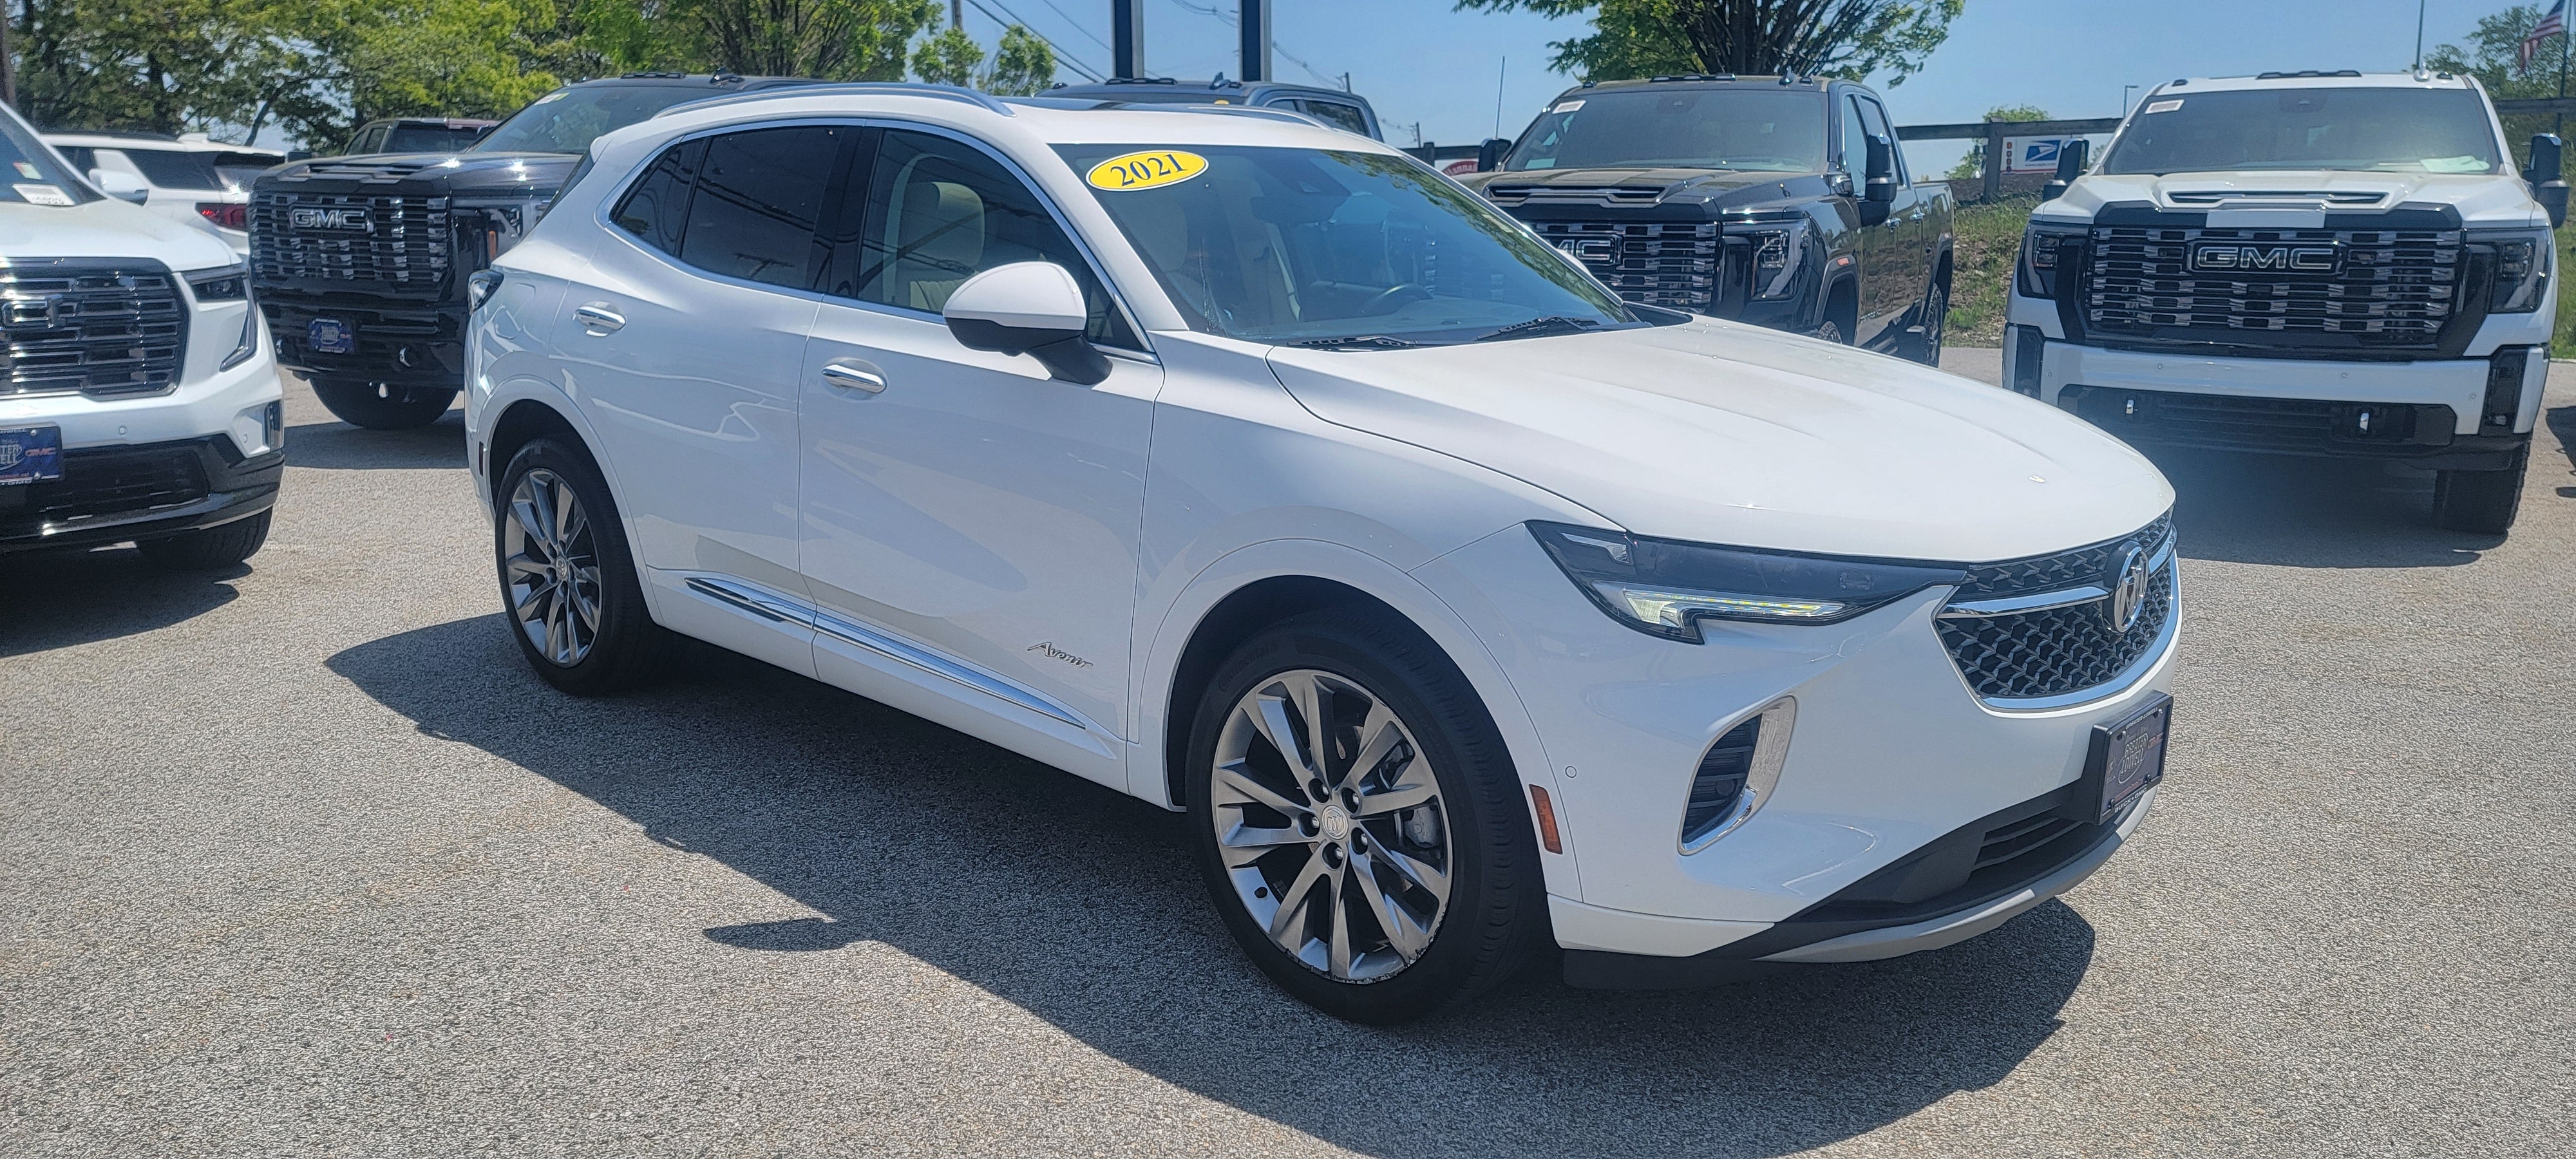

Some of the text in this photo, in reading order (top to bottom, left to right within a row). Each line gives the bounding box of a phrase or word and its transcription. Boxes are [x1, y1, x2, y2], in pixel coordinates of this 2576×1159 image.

[1110, 153, 1188, 187] 2021
[292, 209, 365, 229] GMC
[2197, 247, 2334, 269] GMC
[1027, 641, 1094, 668] Avenir
[2114, 798, 2132, 813] BUICK
[2134, 787, 2147, 799] GMC
